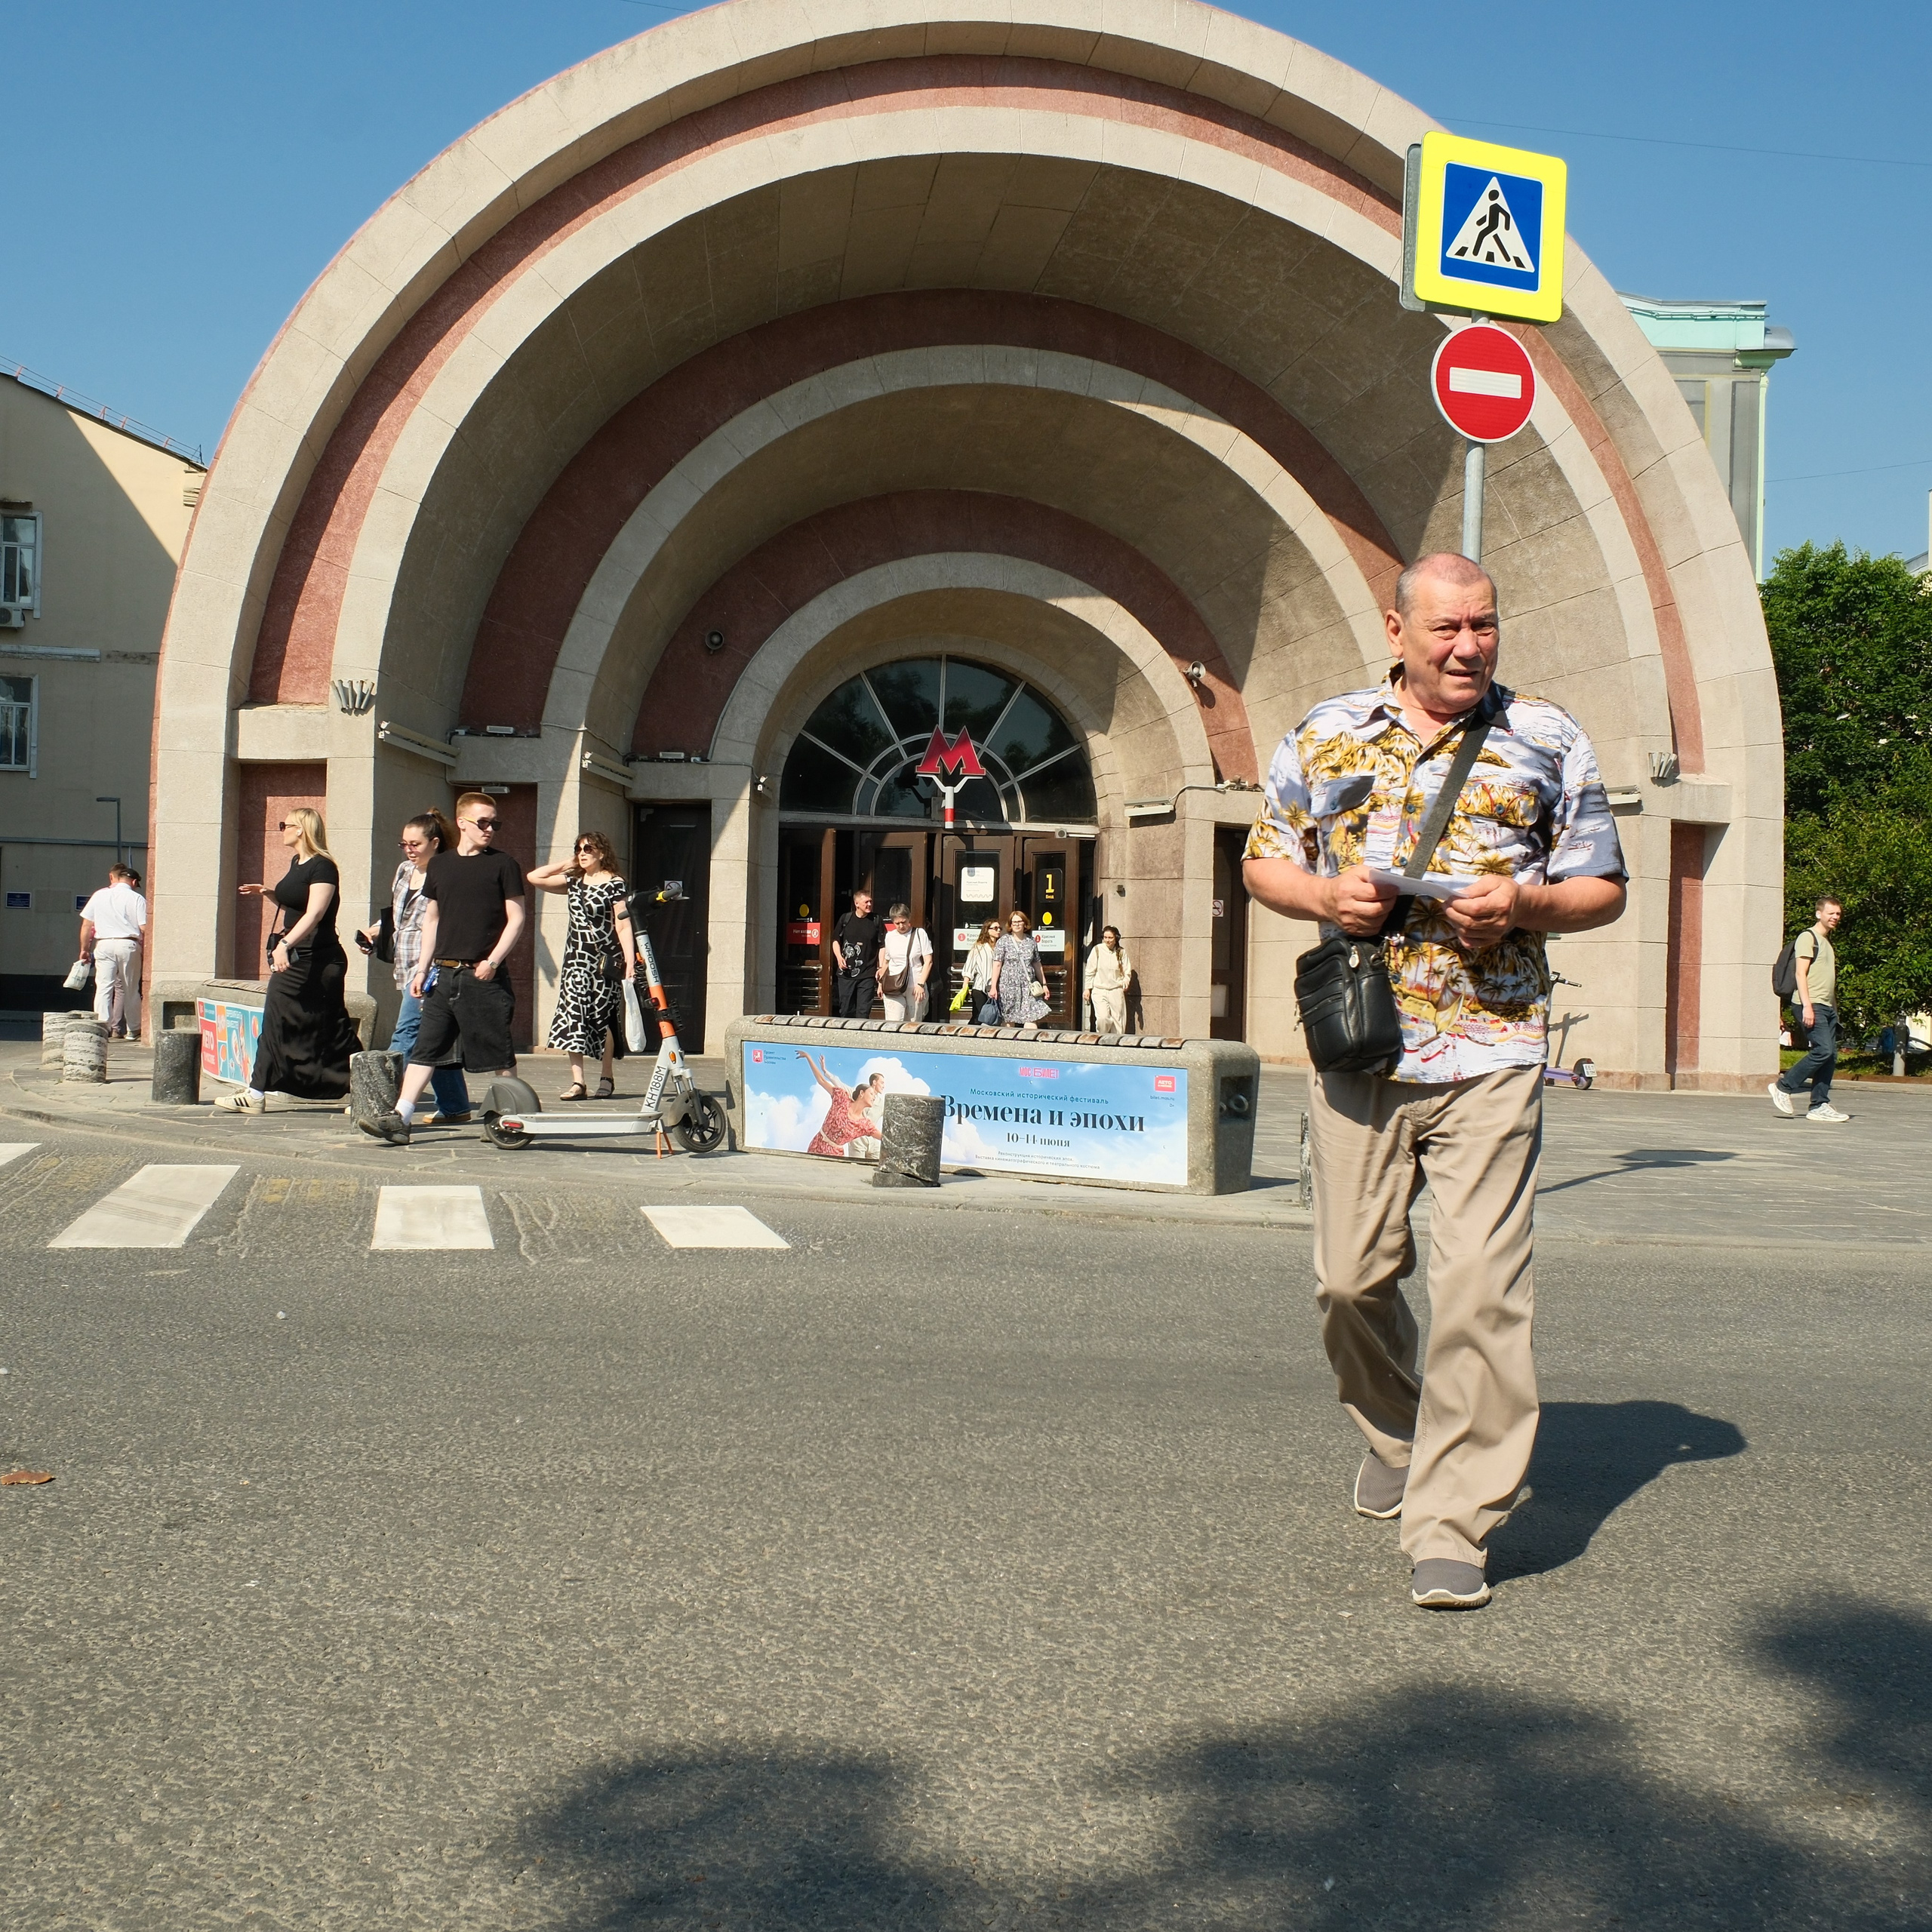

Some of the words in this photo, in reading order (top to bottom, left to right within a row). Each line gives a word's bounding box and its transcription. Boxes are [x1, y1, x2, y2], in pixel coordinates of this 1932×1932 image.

[1045, 874, 1054, 893] 1
[645, 942, 659, 983] WHOOSH
[203, 1029, 214, 1051] ЛЕТО
[970, 1088, 1014, 1097] Московский
[1017, 1092, 1068, 1102] исторический
[1069, 1095, 1109, 1104] фестиваль
[940, 1094, 1041, 1124] Времена
[1049, 1110, 1063, 1126] и
[1069, 1111, 1144, 1131] эпохи
[1040, 1138, 1070, 1147] июня
[995, 1156, 1045, 1165] кинематографического
